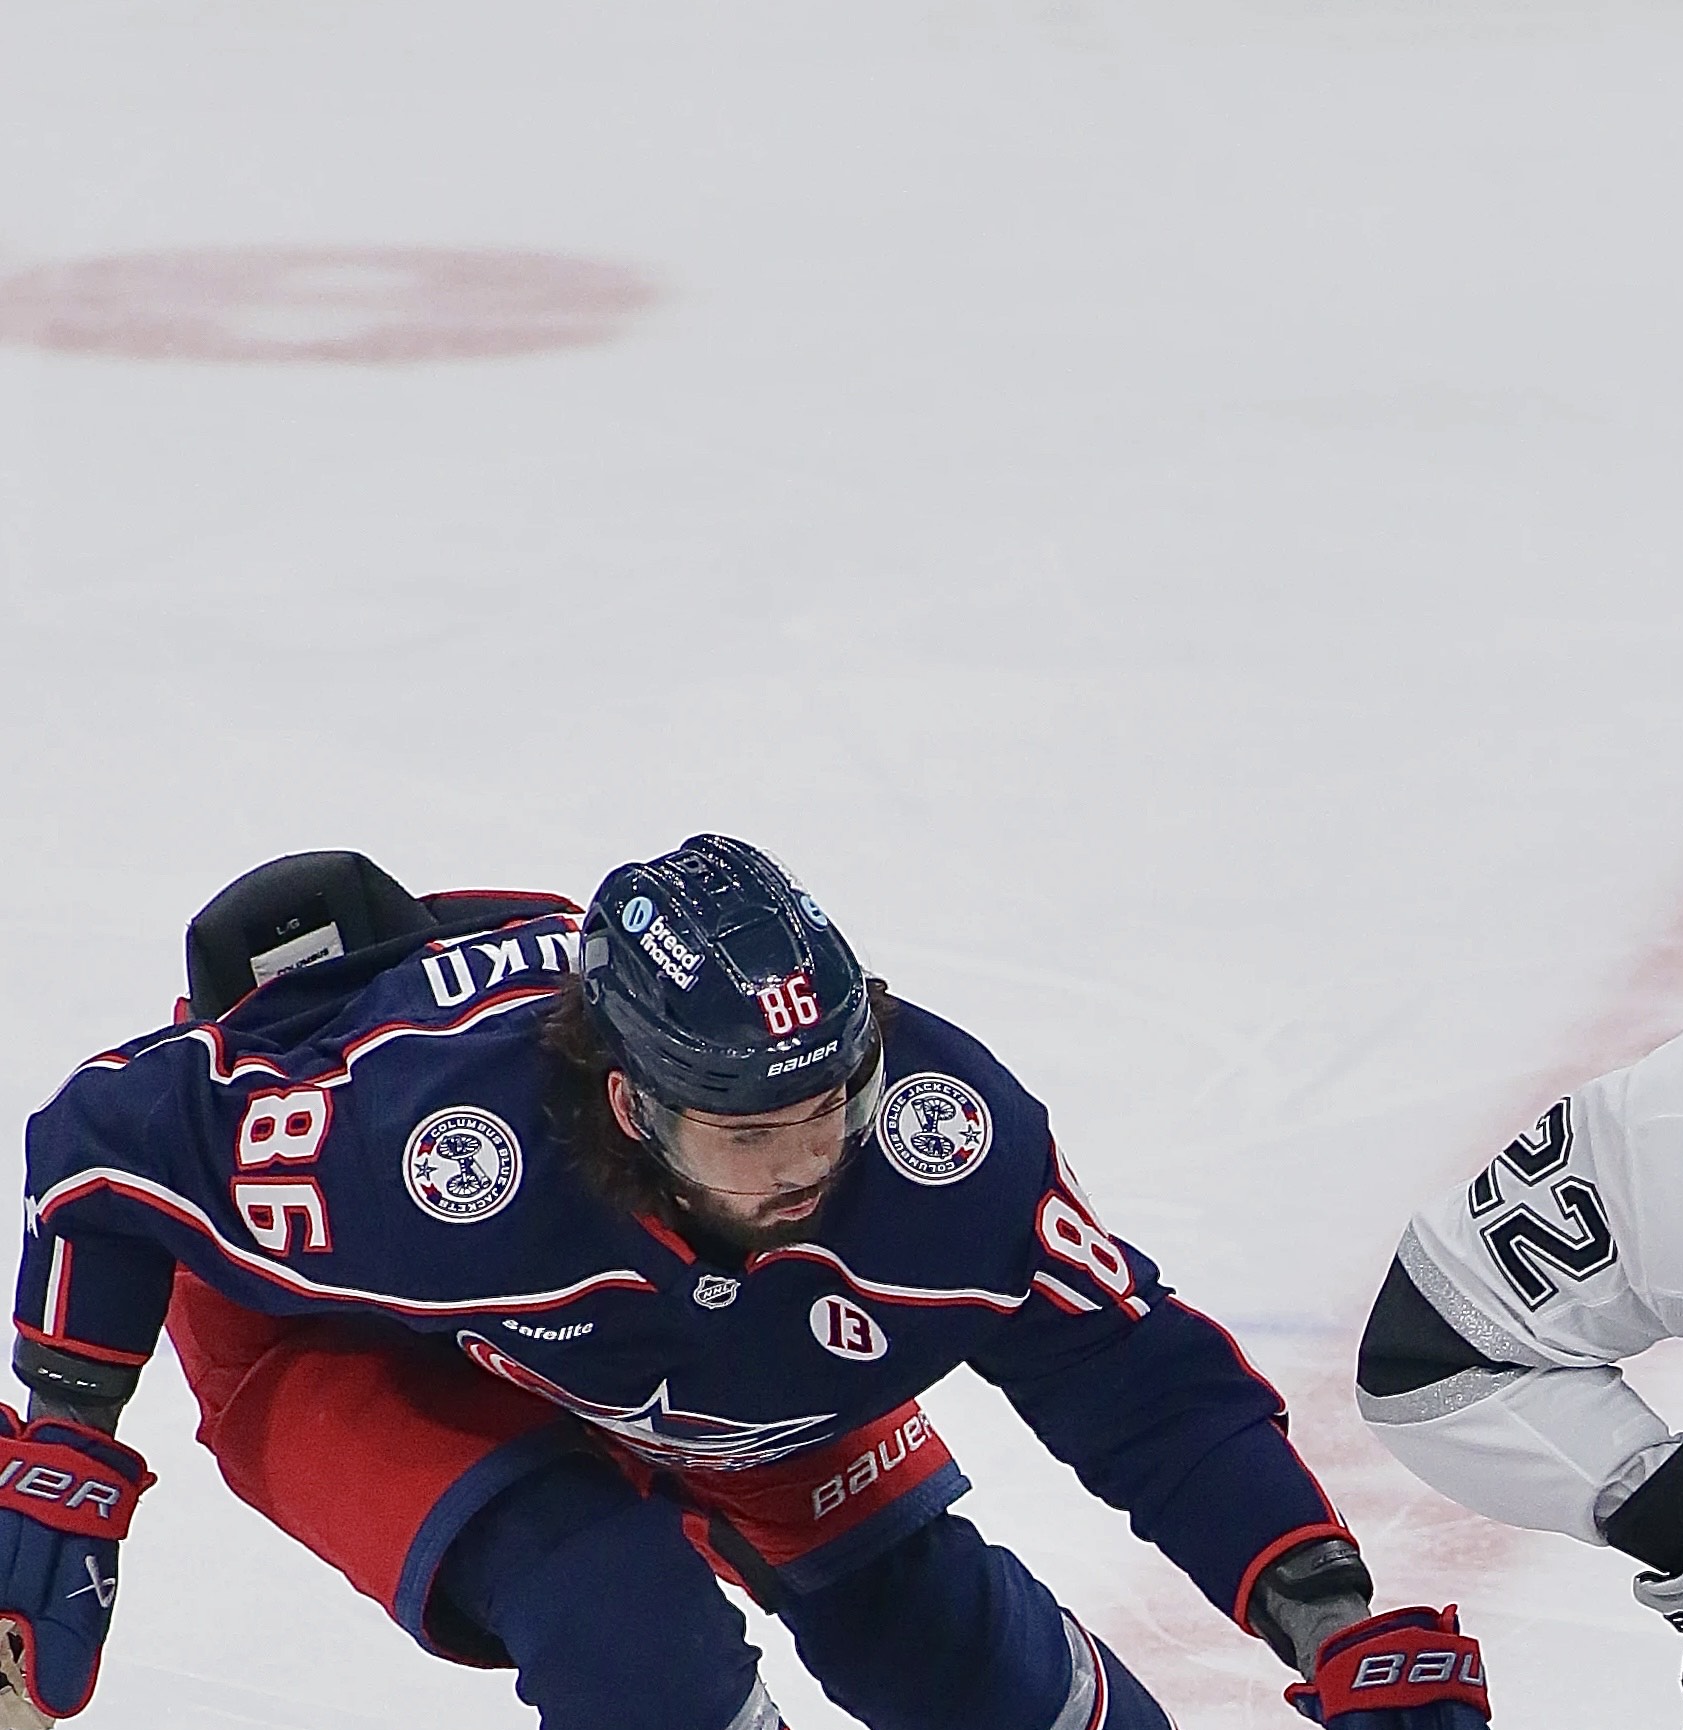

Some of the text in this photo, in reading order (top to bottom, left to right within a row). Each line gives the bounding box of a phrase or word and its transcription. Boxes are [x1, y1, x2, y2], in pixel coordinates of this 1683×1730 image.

[640, 933, 694, 989] financial
[648, 915, 700, 970] bread
[757, 972, 820, 1036] 86
[767, 1040, 838, 1077] BAUER
[889, 1083, 968, 1173] COLUMBUS BLUE JACKETS
[229, 1085, 334, 1259] 86
[430, 1119, 510, 1212] COLUMBUS BLUE JACKETS
[826, 1300, 873, 1354] 13
